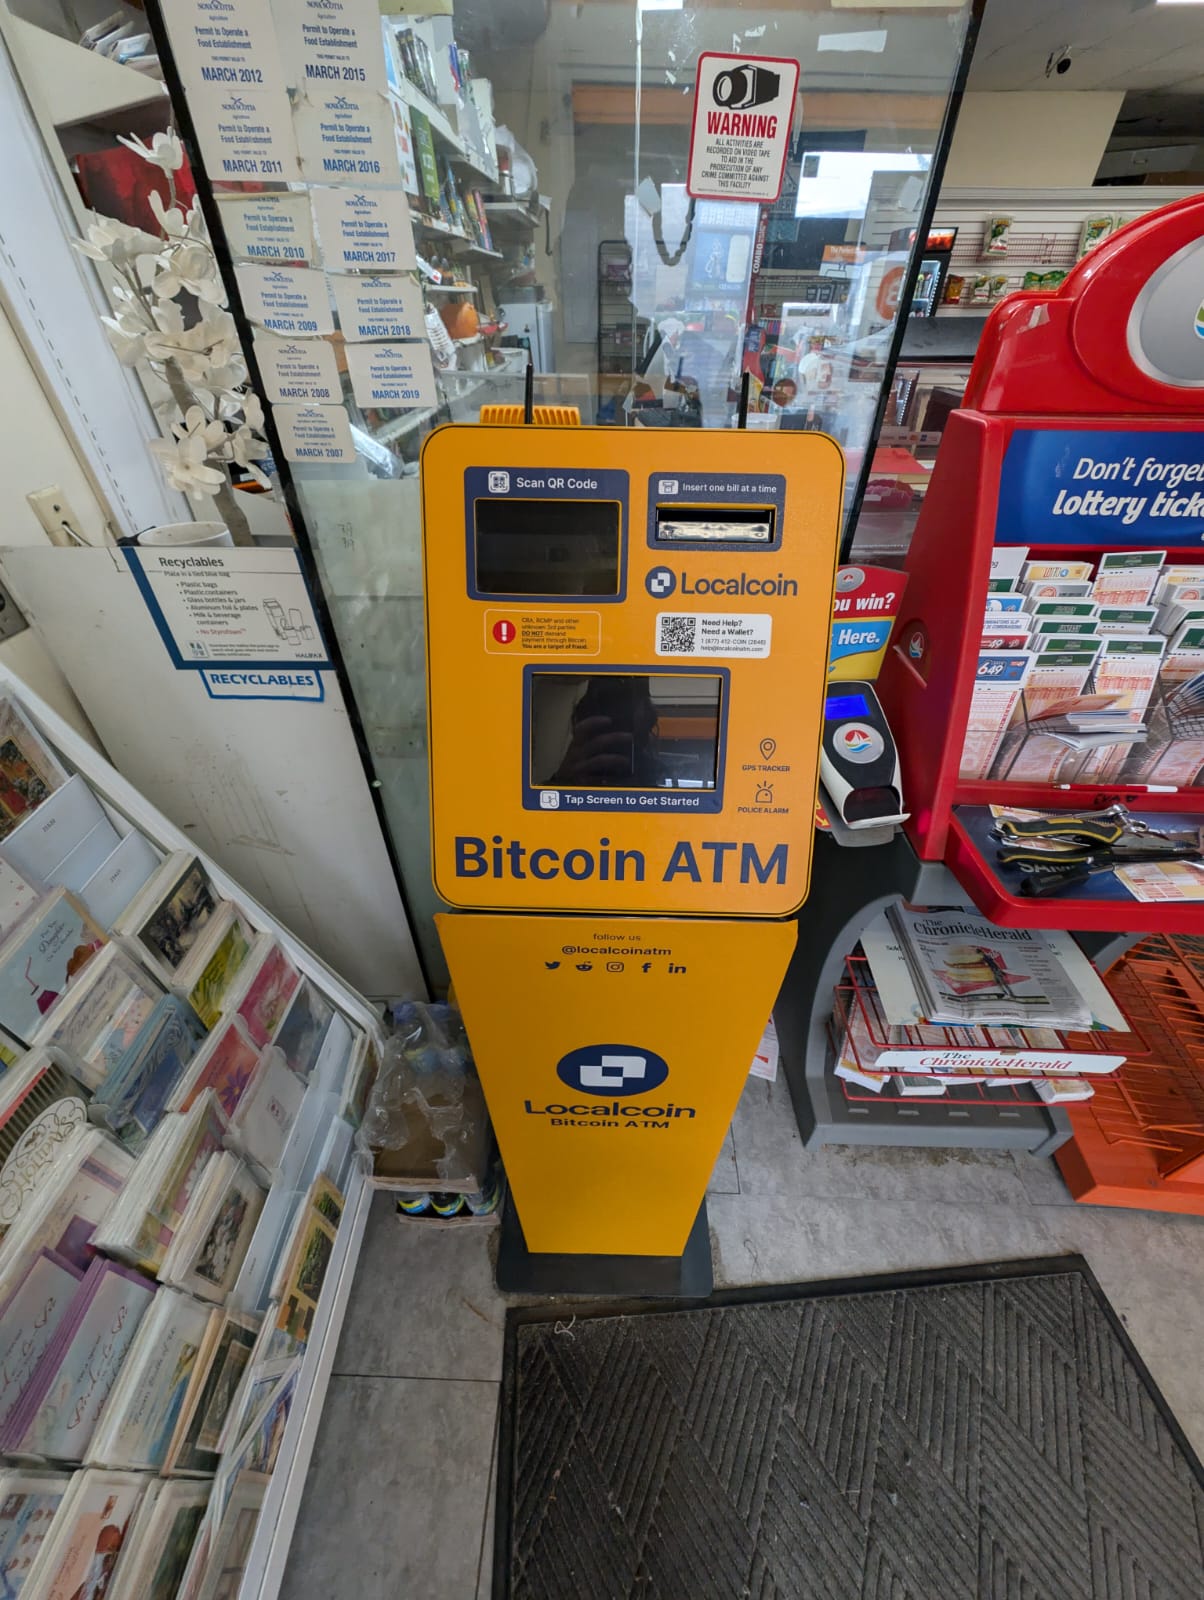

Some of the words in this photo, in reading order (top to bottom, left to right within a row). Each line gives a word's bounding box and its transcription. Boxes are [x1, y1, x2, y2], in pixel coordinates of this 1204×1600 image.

[195, 26, 214, 35] Permit
[215, 27, 221, 35] to
[222, 27, 244, 37] Operate
[302, 24, 321, 33] Permit
[322, 26, 328, 34] to
[329, 26, 350, 35] Operate
[197, 39, 212, 47] Food
[212, 40, 252, 49] Establishment
[304, 37, 318, 45] Food
[319, 38, 358, 48] Establishment
[201, 67, 238, 81] MARCH
[239, 69, 263, 82] 2012
[305, 64, 340, 79] MARCH
[343, 67, 366, 81] 2015
[708, 112, 778, 138] WARNING
[716, 138, 725, 146] ALL
[726, 139, 752, 148] ACTIVITIES
[706, 146, 734, 155] RECORDED
[742, 148, 757, 156] VIDEO
[759, 150, 770, 158] TAPE
[223, 160, 258, 172] MARCH
[260, 160, 282, 173] 2011
[323, 159, 356, 172] MARCH
[358, 161, 380, 173] 2016
[710, 163, 744, 172] PROSECUTION
[701, 171, 717, 179] CRIME
[718, 172, 747, 181] COMMITTED
[749, 174, 768, 182] AGAINST
[730, 181, 750, 189] FACILITY
[247, 245, 280, 257] MARCH
[283, 246, 305, 258] 2010
[344, 251, 374, 262] MARCH
[376, 252, 396, 262] 2017
[753, 244, 763, 273] COMBO
[264, 319, 295, 330] MARCH
[297, 321, 318, 331] 2009
[359, 325, 388, 336] MARCH
[391, 326, 411, 335] 2018
[280, 388, 308, 397] MARCH
[372, 390, 400, 399] MARCH
[401, 390, 419, 399] 2019
[296, 448, 323, 456] MARCH
[326, 448, 343, 457] 2007
[1072, 456, 1136, 481] Don't
[516, 478, 545, 488] Scan
[548, 478, 564, 489] QR
[567, 478, 598, 489] Code
[682, 483, 707, 491] Insert
[727, 484, 739, 492] bill
[758, 485, 776, 493] time
[1052, 490, 1147, 525] lottery
[158, 557, 224, 568] Recyclables
[681, 572, 798, 597] Localcoin
[833, 599, 851, 612] ou
[856, 592, 895, 610] win?
[838, 629, 880, 646] Here.
[990, 639, 1003, 648] 49
[210, 673, 314, 686] RECYCLABLES
[565, 795, 584, 805] Tap
[586, 795, 623, 804] Screen
[626, 796, 636, 805] to
[639, 796, 658, 805] Get
[660, 796, 699, 806] Started
[454, 835, 645, 881] Bitcoin
[662, 841, 788, 884] ATM
[923, 918, 943, 927] The
[562, 946, 671, 956] @localcoinatm
[524, 1102, 696, 1118] Localcoin
[551, 1119, 619, 1128] Bitcoin
[625, 1120, 669, 1128] ATM
